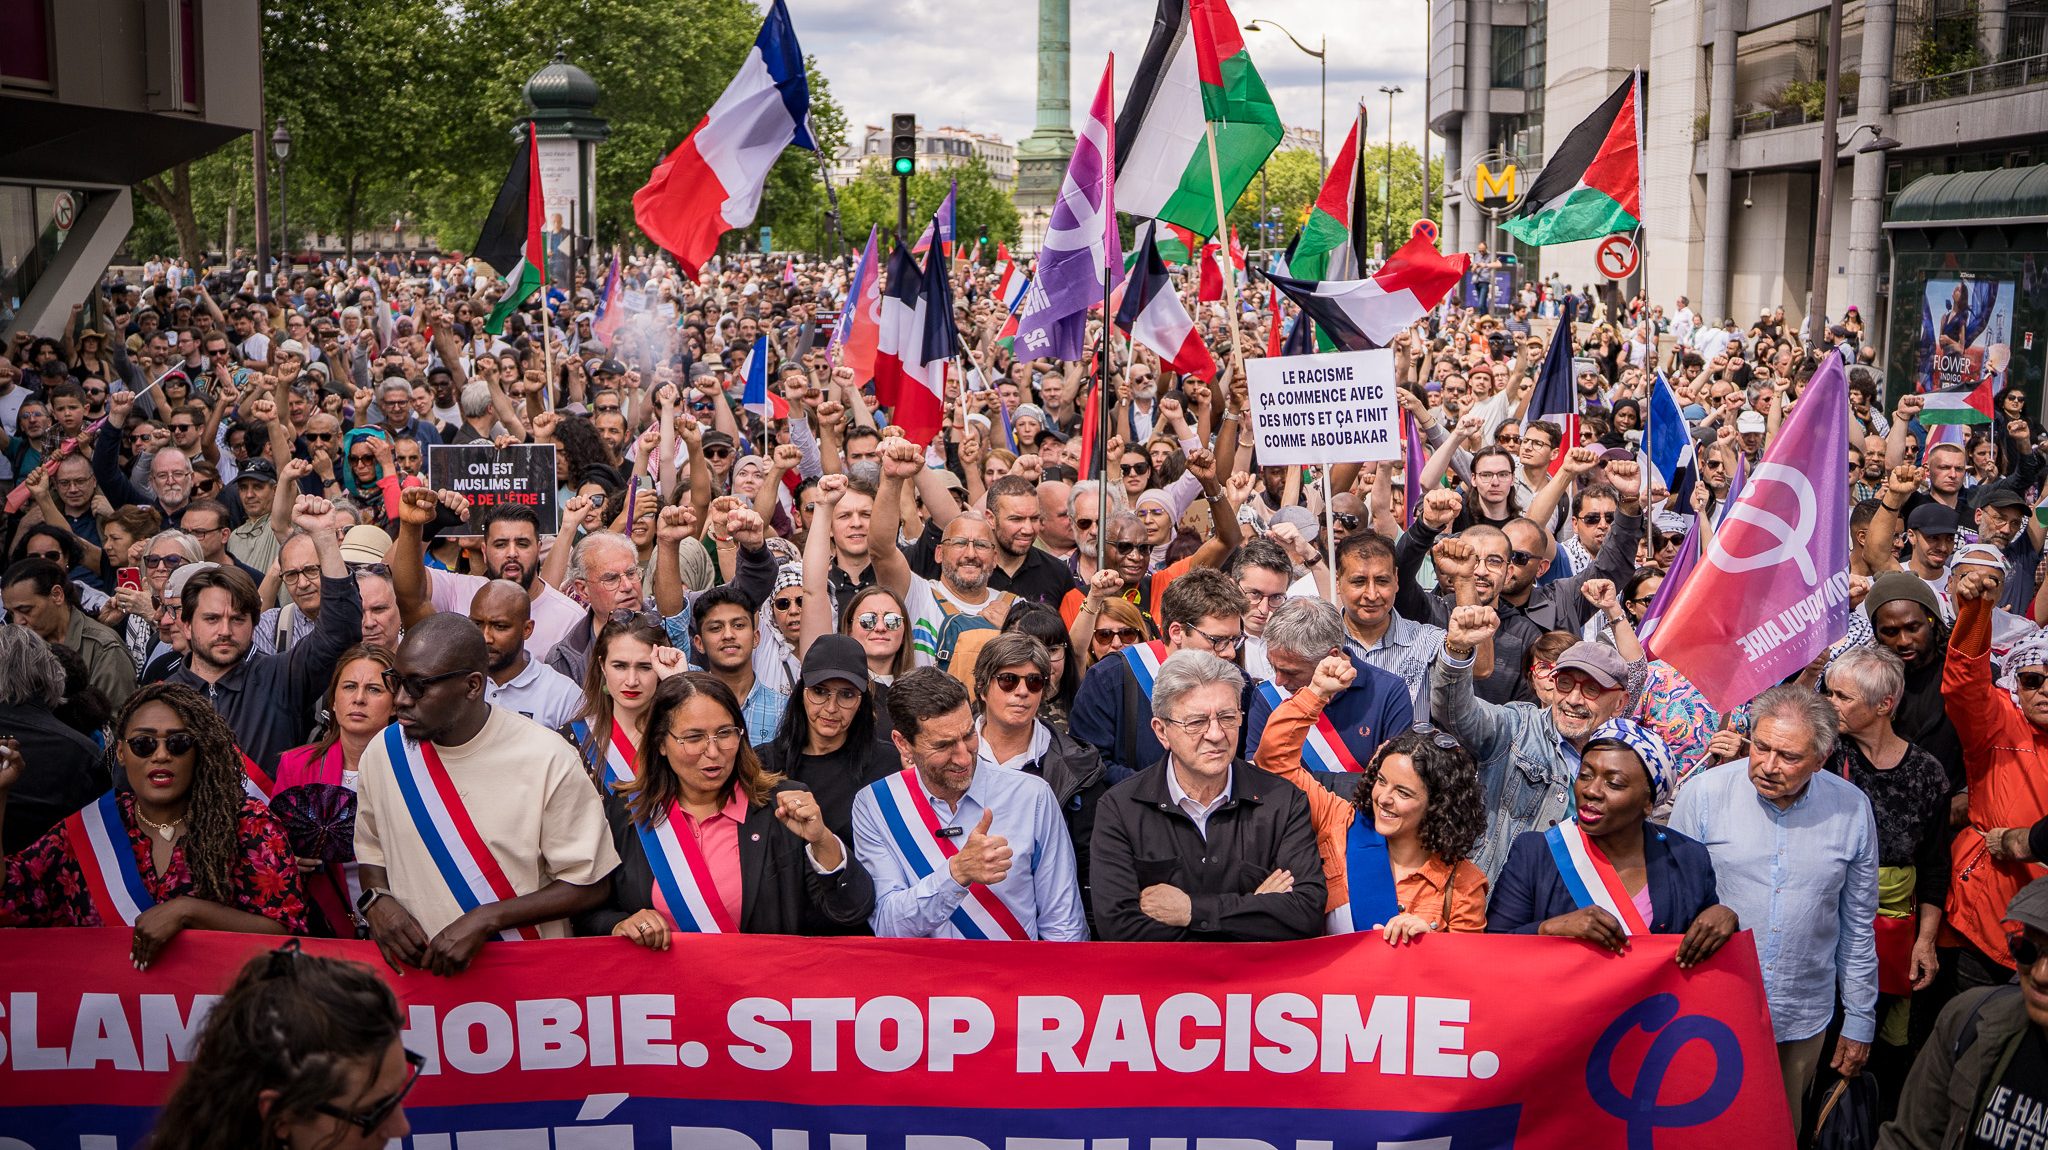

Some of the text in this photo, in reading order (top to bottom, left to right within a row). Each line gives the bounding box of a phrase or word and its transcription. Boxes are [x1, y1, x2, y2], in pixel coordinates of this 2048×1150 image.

[1476, 164, 1517, 202] M
[1933, 354, 1971, 374] FLOWER
[1282, 366, 1353, 385] LE RACISME
[1940, 372, 1962, 382] INDIGO
[1260, 386, 1384, 410] ÇA COMMENCE AVEC
[1259, 407, 1388, 428] DES MOTS ET ÇA FINIT
[1264, 429, 1388, 448] COMME ABOUBAKAR
[468, 462, 513, 475] ON EST
[454, 478, 528, 490] MUSLIMS ET
[478, 494, 494, 505] DE
[728, 995, 994, 1075] STOP
[1016, 992, 1500, 1080] RACISME.
